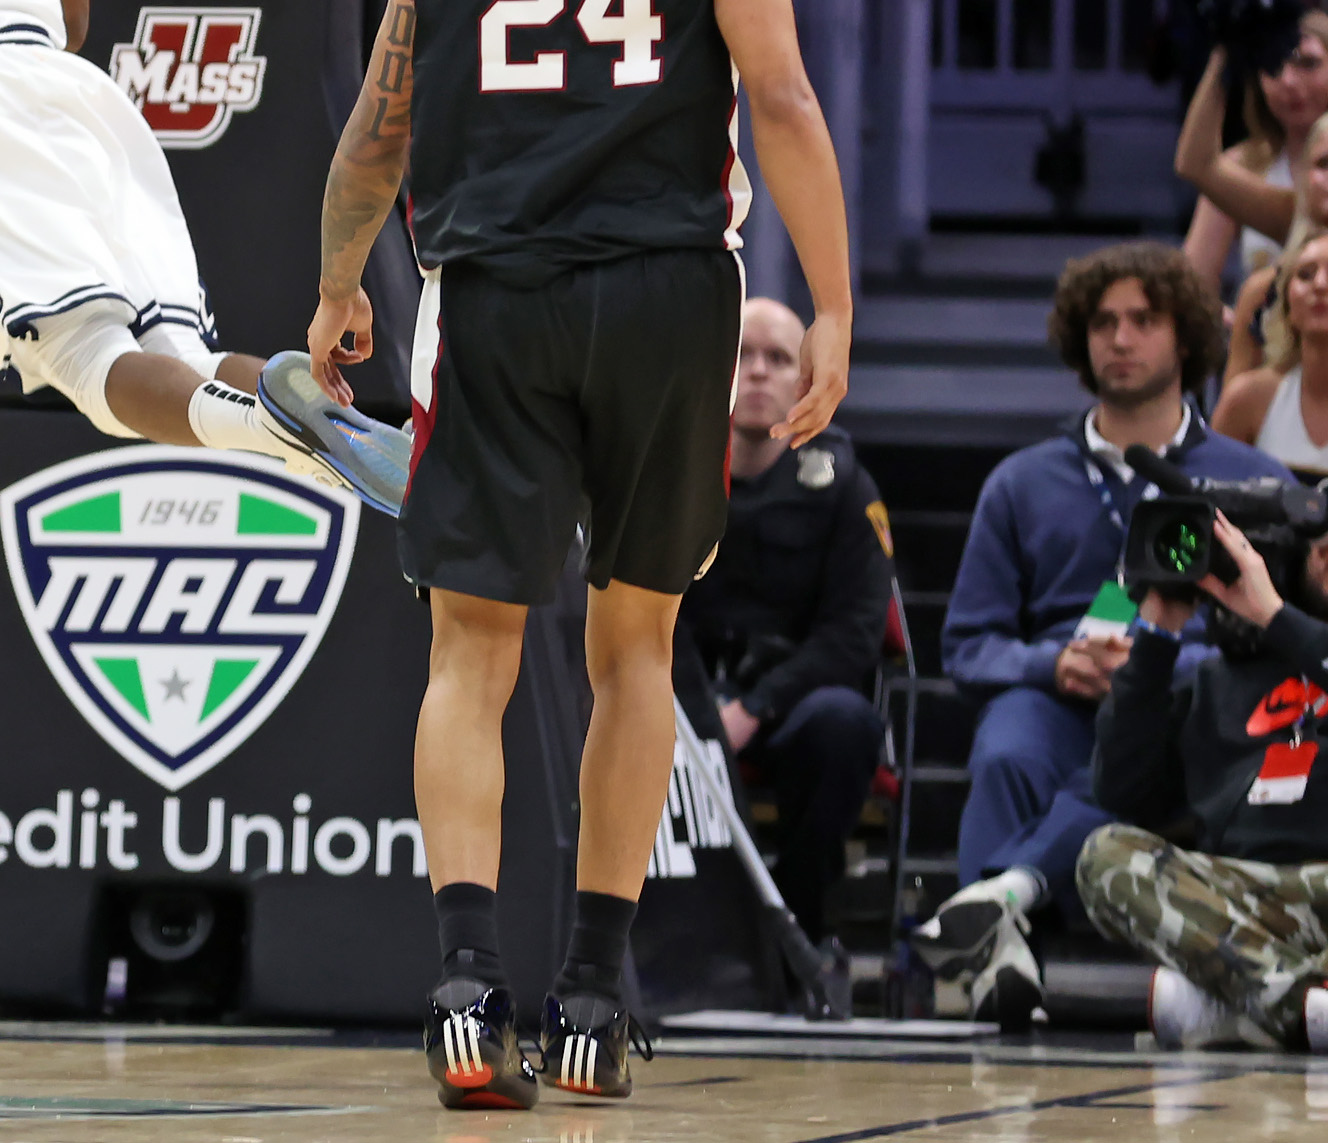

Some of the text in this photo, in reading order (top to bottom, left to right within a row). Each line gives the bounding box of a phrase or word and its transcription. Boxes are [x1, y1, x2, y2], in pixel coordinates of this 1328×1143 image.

[137, 499, 224, 527] 1946
[34, 556, 318, 634] MAC
[162, 792, 429, 877] Union
